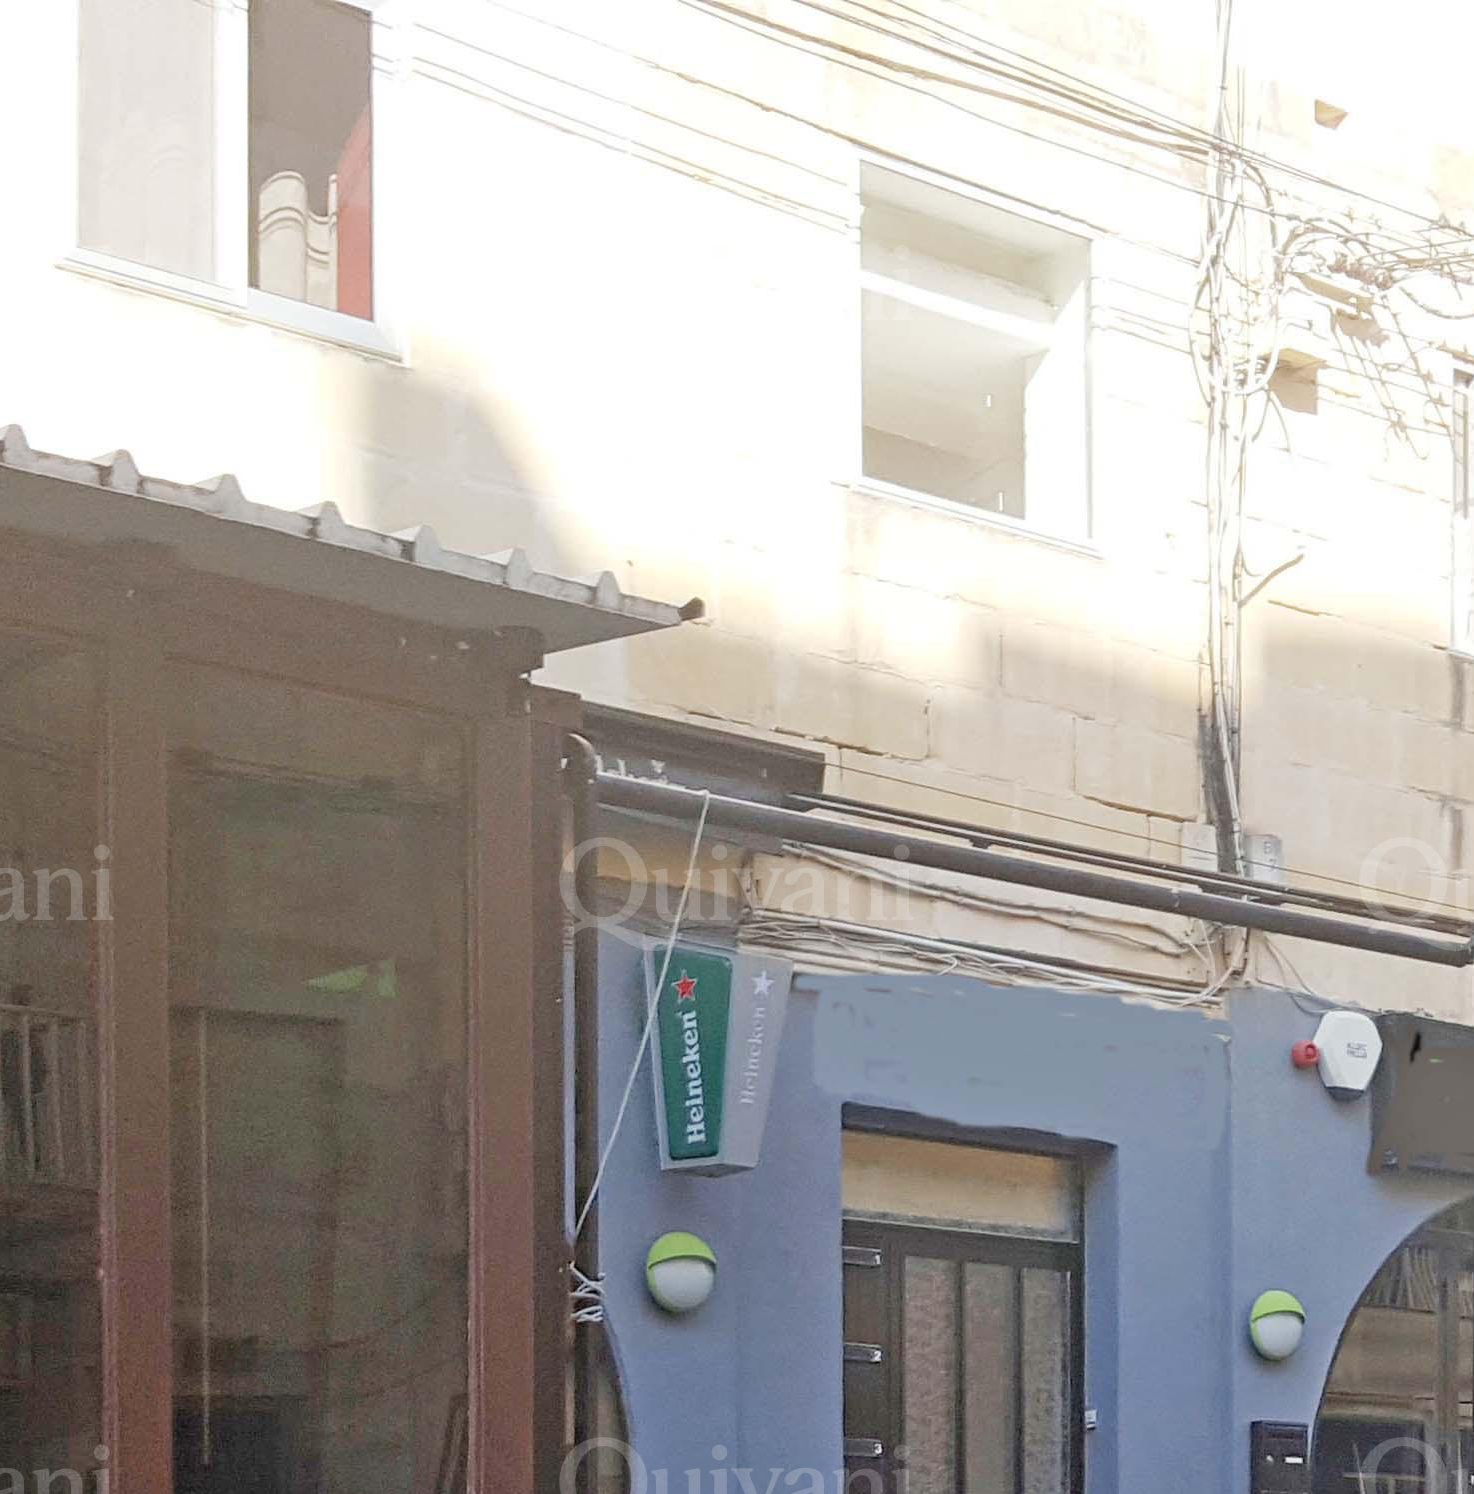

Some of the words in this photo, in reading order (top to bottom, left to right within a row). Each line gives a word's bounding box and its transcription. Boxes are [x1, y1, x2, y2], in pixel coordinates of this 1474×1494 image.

[680, 1010, 707, 1145] Heineken
[740, 1006, 766, 1104] Heineken
[873, 1443, 883, 1454] 3
